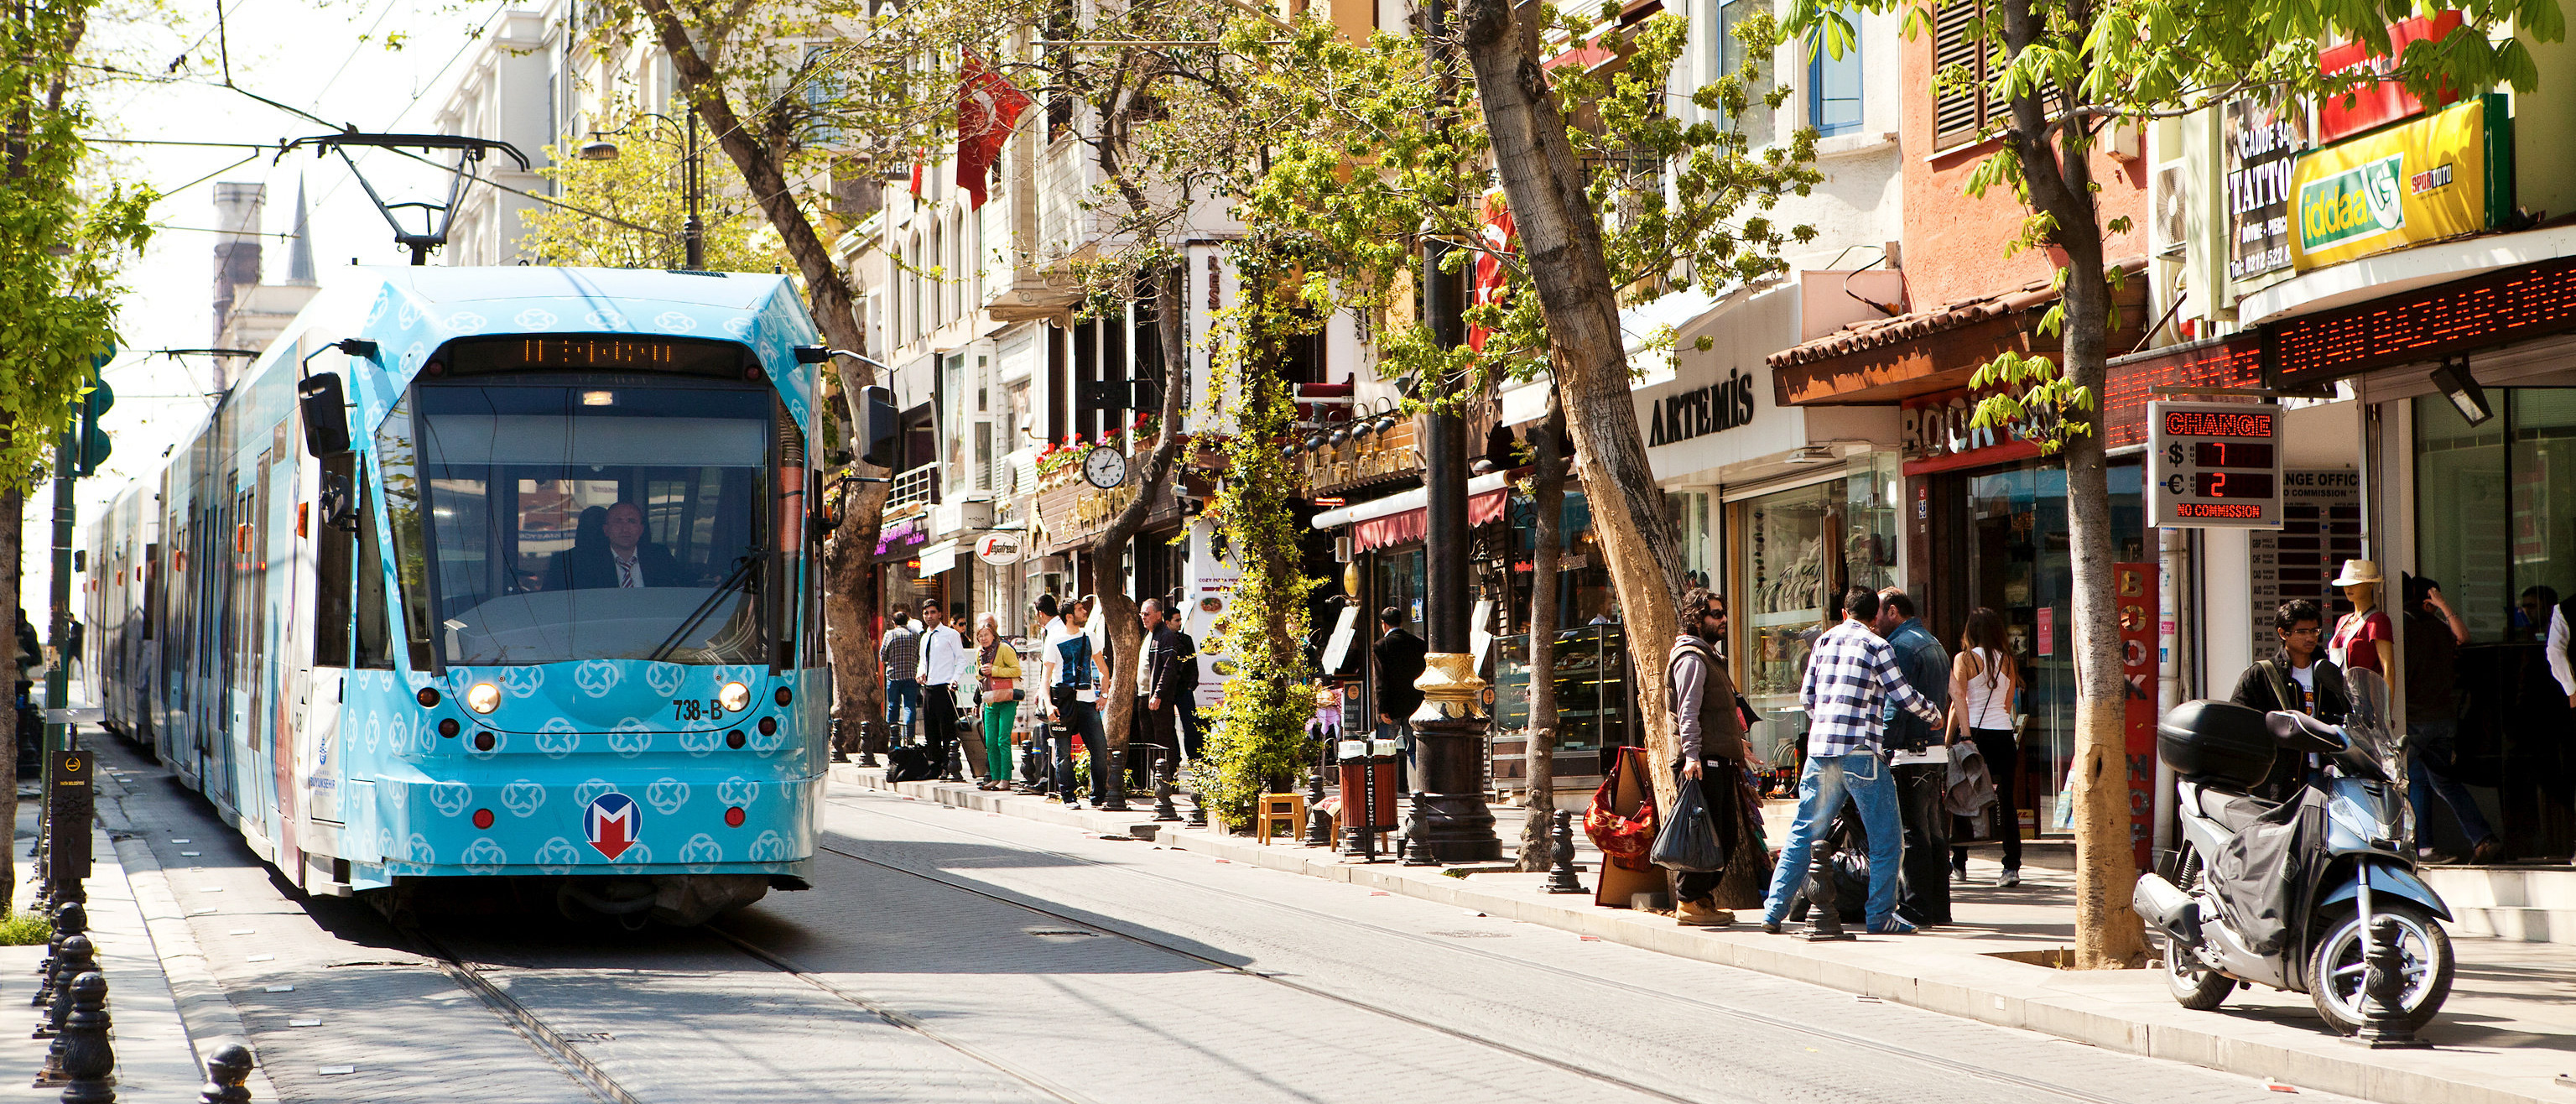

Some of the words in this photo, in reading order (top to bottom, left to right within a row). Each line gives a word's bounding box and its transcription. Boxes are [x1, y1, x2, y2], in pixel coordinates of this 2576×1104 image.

[2242, 123, 2275, 159] CADDE
[2277, 118, 2290, 149] 34
[2229, 155, 2297, 216] TATTO
[2304, 185, 2368, 240] iddaa
[2230, 260, 2245, 279] Tel:
[2246, 247, 2266, 273] 0212
[2267, 245, 2283, 267] 522
[1648, 367, 1754, 448] ARTEMİS
[1902, 389, 2004, 462] BOOK
[2166, 412, 2272, 437] CHANGE
[2213, 442, 2225, 466] 7
[2210, 472, 2225, 497] 2
[2318, 473, 2360, 487] OFFIC
[2292, 489, 2347, 498] COMMISSION
[2178, 504, 2192, 517] NO
[2194, 504, 2260, 518] COMMISSION
[983, 539, 1017, 555] Segafredo
[2120, 570, 2147, 700] BOOK
[673, 698, 723, 721] 738-B
